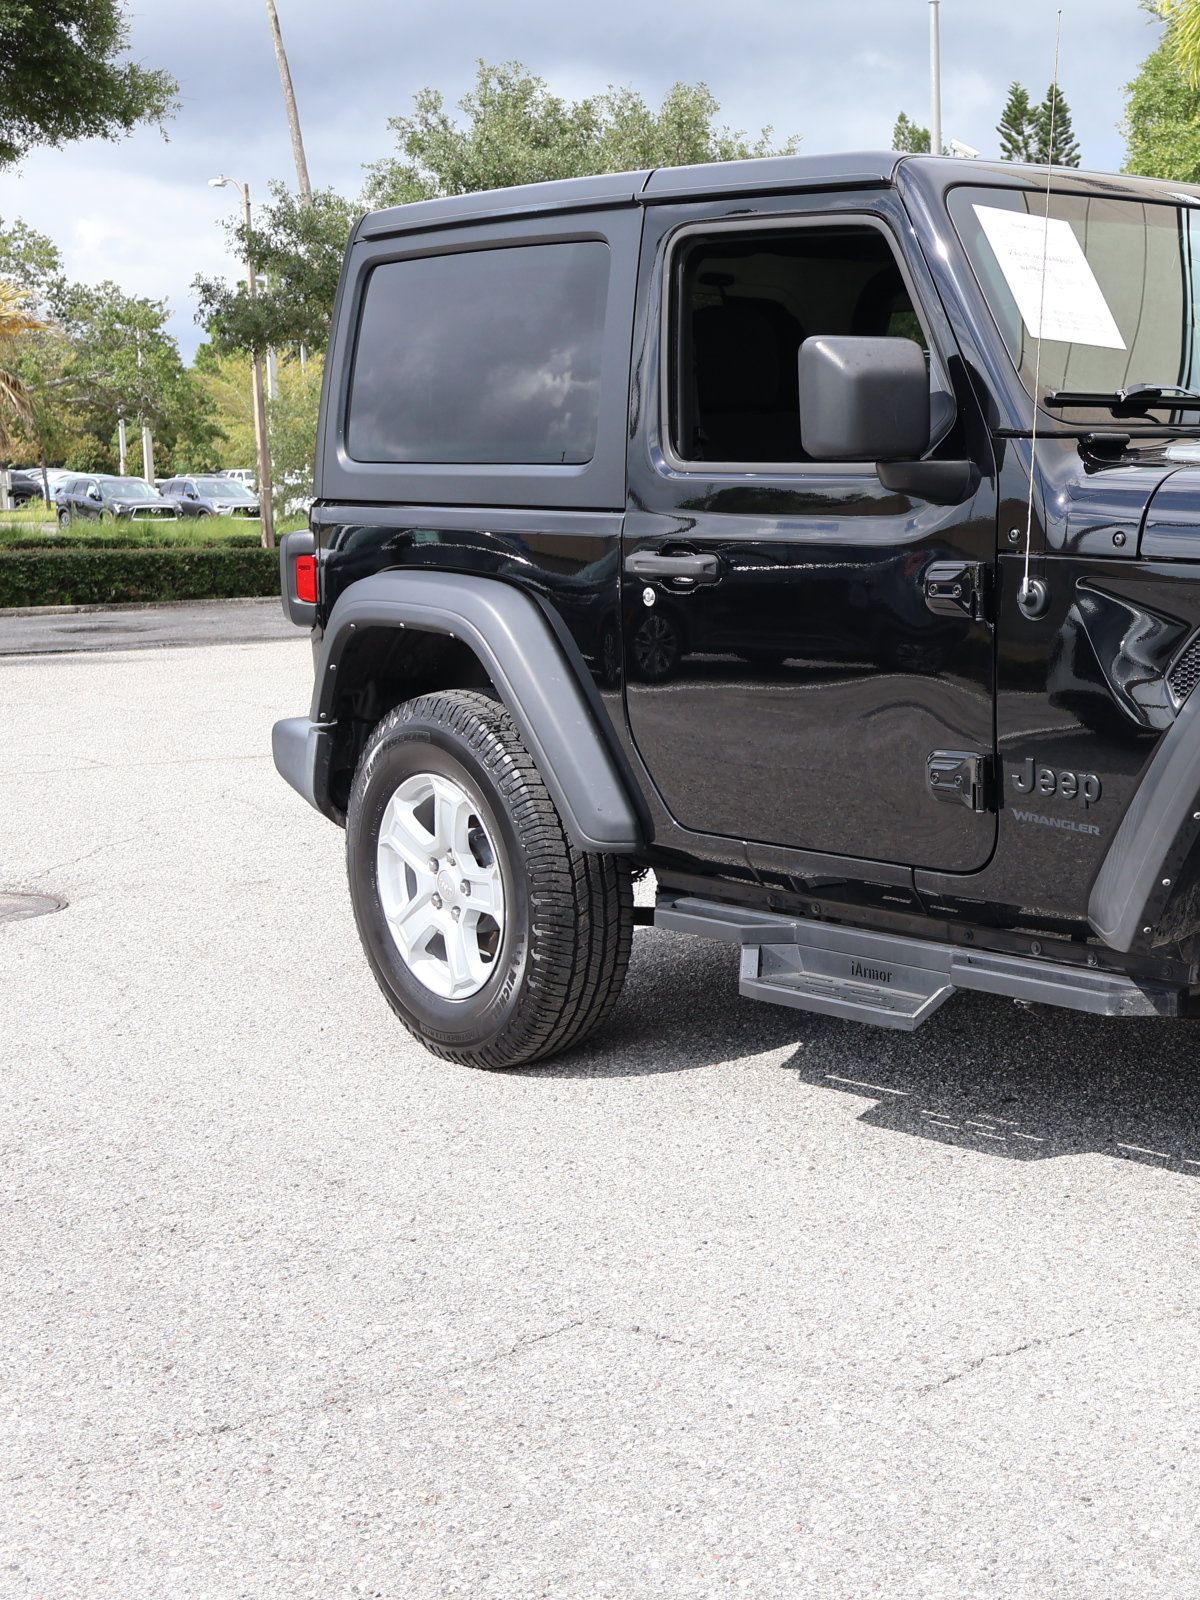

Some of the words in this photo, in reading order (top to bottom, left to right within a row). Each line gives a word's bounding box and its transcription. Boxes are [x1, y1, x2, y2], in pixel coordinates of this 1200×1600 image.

[1012, 757, 1102, 809] Jeep
[1010, 807, 1101, 836] WRANGLER
[850, 960, 893, 983] iArmor
